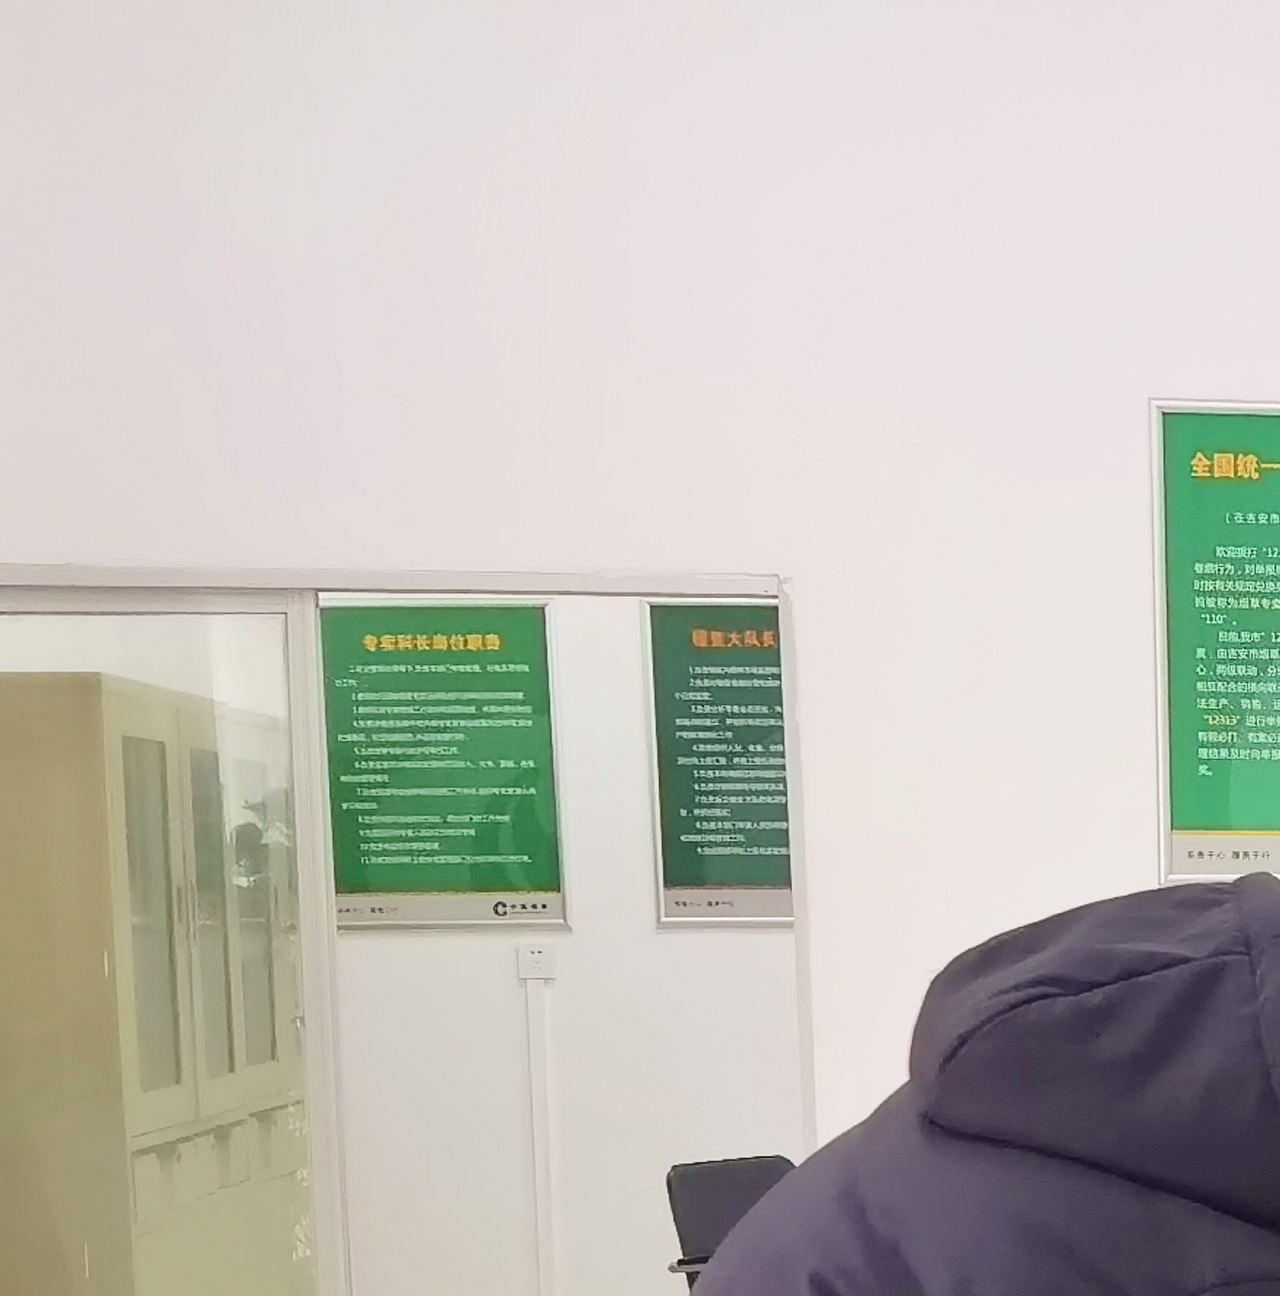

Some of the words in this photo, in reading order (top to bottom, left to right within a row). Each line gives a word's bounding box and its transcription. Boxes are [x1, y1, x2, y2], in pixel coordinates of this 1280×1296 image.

[363, 634, 501, 651] 专卖科长岗位职责
